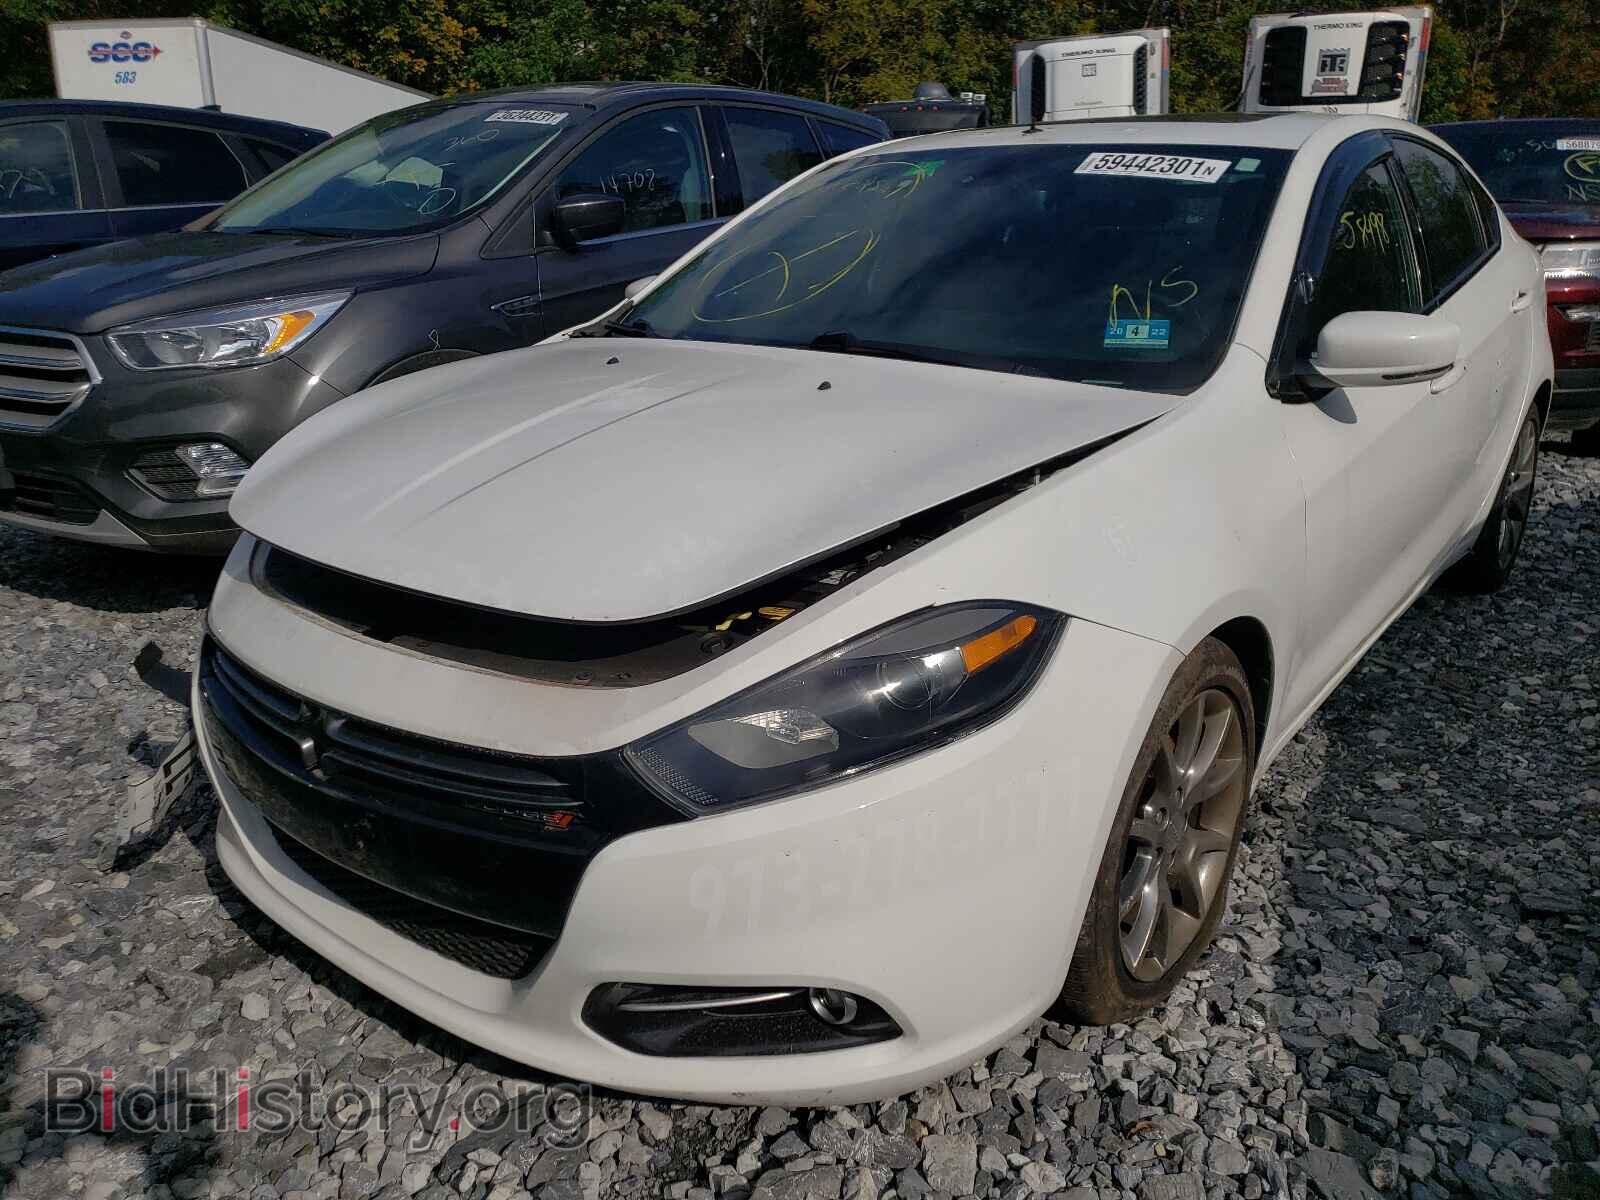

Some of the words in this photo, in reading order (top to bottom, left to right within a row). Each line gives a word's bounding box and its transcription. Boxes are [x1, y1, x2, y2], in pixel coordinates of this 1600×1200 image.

[114, 71, 137, 84] 583
[1094, 154, 1206, 177] 59442301
[1131, 326, 1139, 337] 4
